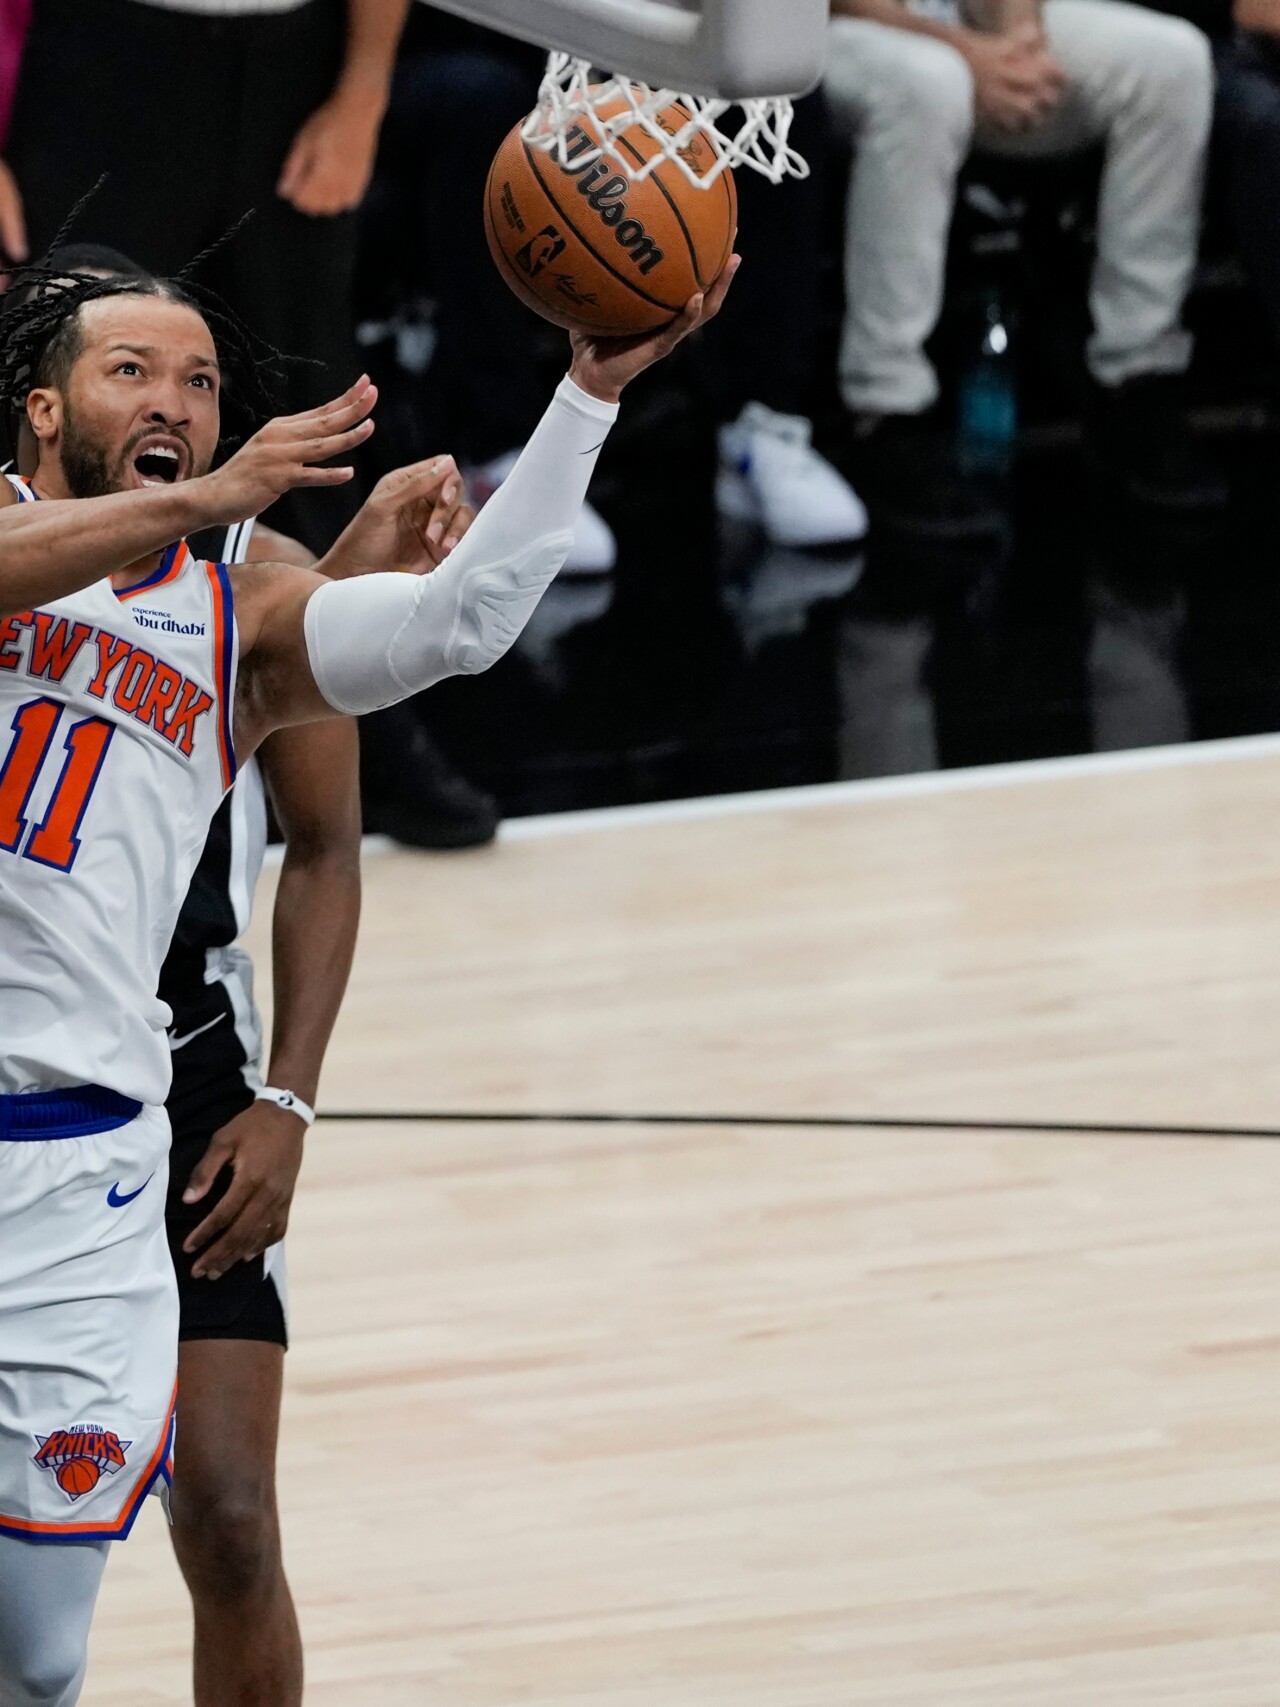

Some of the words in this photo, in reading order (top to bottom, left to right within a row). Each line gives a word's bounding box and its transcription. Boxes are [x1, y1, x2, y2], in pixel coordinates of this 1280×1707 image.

[549, 123, 665, 276] Wilson
[131, 606, 172, 618] experience
[161, 619, 206, 636] dhabi
[84, 629, 214, 760] YORK
[69, 1425, 86, 1434] NEW
[86, 1424, 104, 1434] YORK
[34, 1430, 126, 1470] KNICKS
